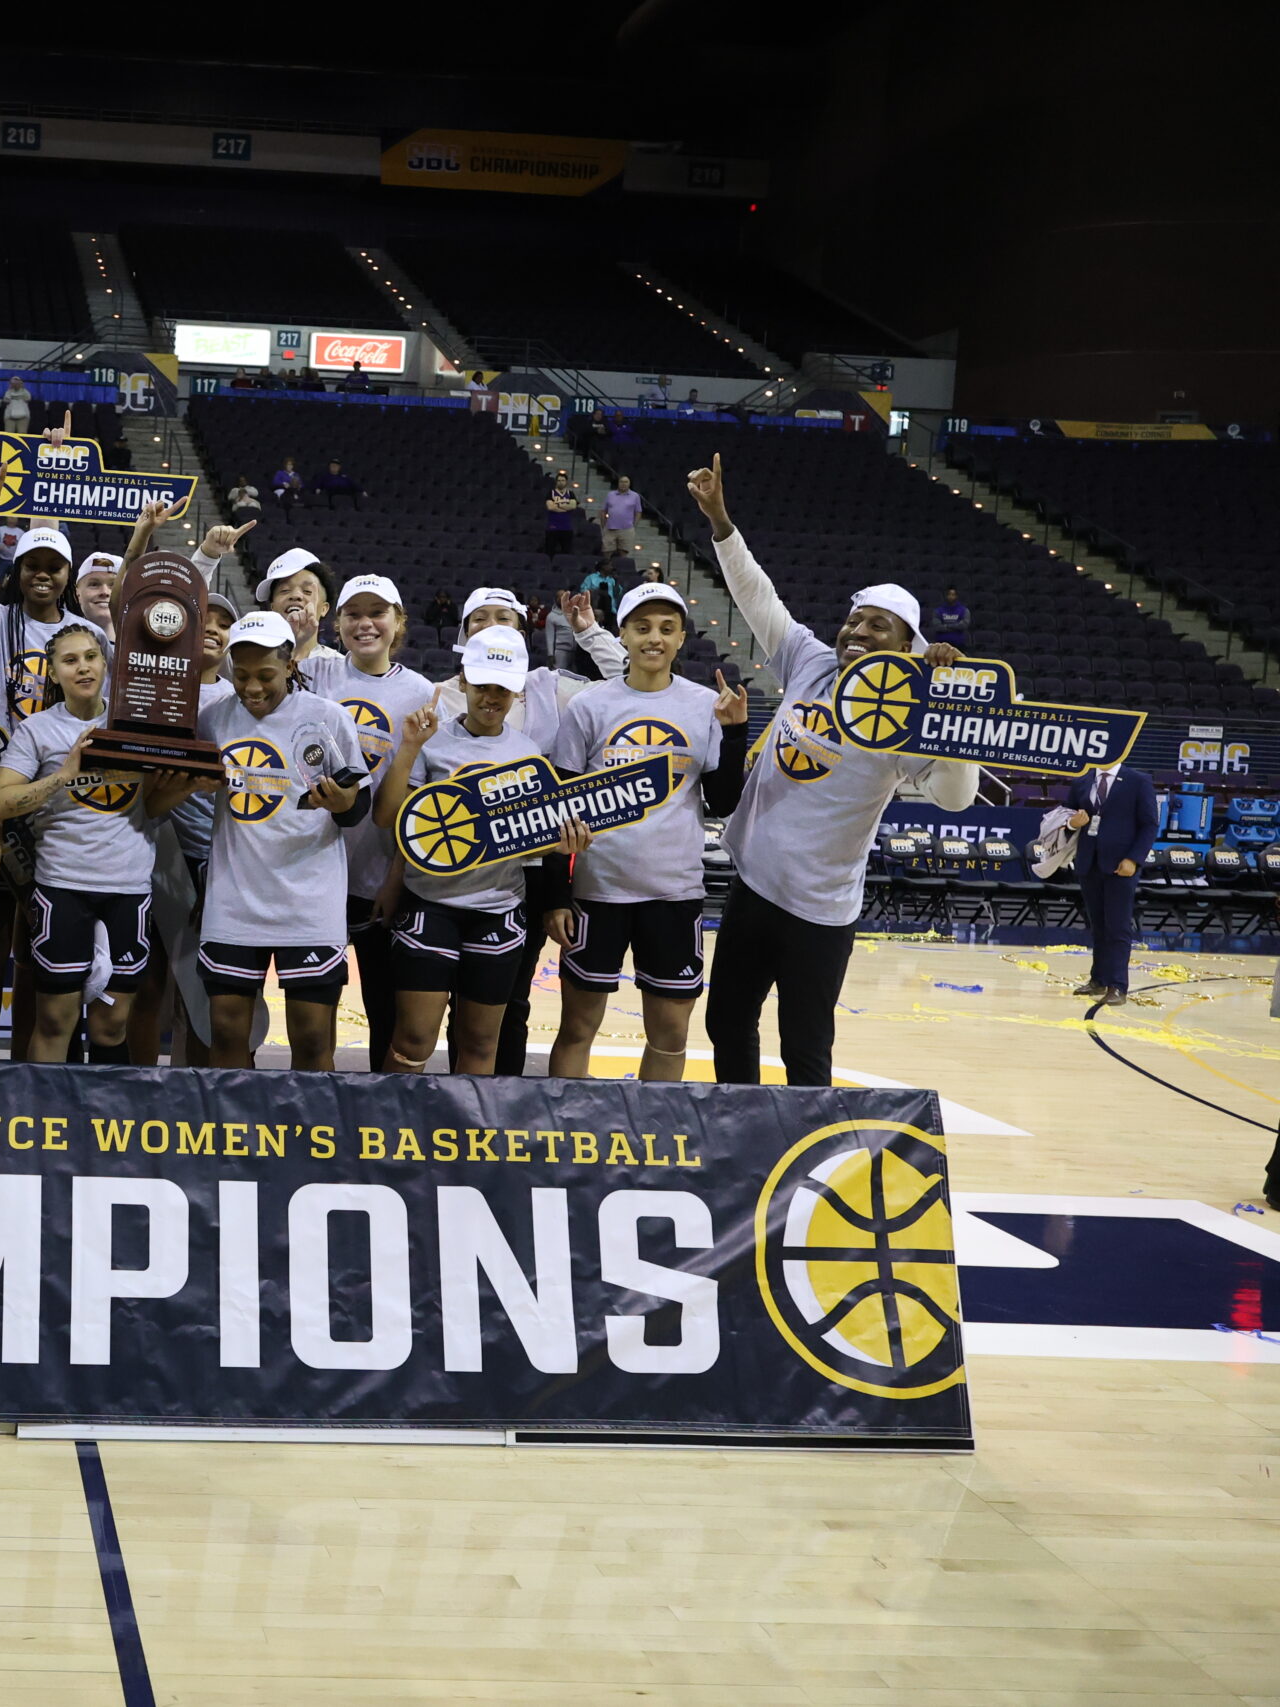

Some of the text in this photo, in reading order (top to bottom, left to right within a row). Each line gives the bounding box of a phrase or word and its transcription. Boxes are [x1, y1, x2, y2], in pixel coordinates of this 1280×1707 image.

[7, 127, 36, 145] 216
[217, 138, 247, 155] 217
[408, 143, 461, 172] SBC
[471, 156, 599, 180] CHAMPIONSHIP
[279, 333, 298, 345] 217
[325, 340, 391, 364] Coca-Cola
[94, 368, 115, 383] 116
[196, 379, 216, 393] 117
[574, 398, 594, 413] 118
[947, 418, 967, 433] 119
[37, 443, 90, 471] SBC
[37, 472, 149, 486] WOMEN'S BASKETBALL
[33, 481, 174, 510] CHAMPIONS
[128, 652, 191, 671] SUN BELT
[128, 666, 187, 678] CONFERENCE
[929, 666, 998, 702] SBC
[928, 701, 1073, 723] WOMEN'S BASKETBALL
[921, 713, 1109, 759] CHAMPIONS
[161, 747, 187, 756] UNIVERSITY
[919, 743, 941, 751] MAR.
[959, 747, 982, 757] MAR.
[985, 750, 995, 758] 10
[1002, 752, 1062, 766] PENSACOLA,
[1066, 760, 1078, 768] FL
[478, 765, 542, 806] SBC
[487, 775, 617, 817] WOMEN'S BASKETBALL
[490, 777, 656, 844] CHAMPIONS
[498, 844, 519, 853] MAR.
[534, 834, 556, 844] MAR.
[92, 1118, 336, 1159] WOMEN'S
[359, 1127, 702, 1167] BASKETBALL
